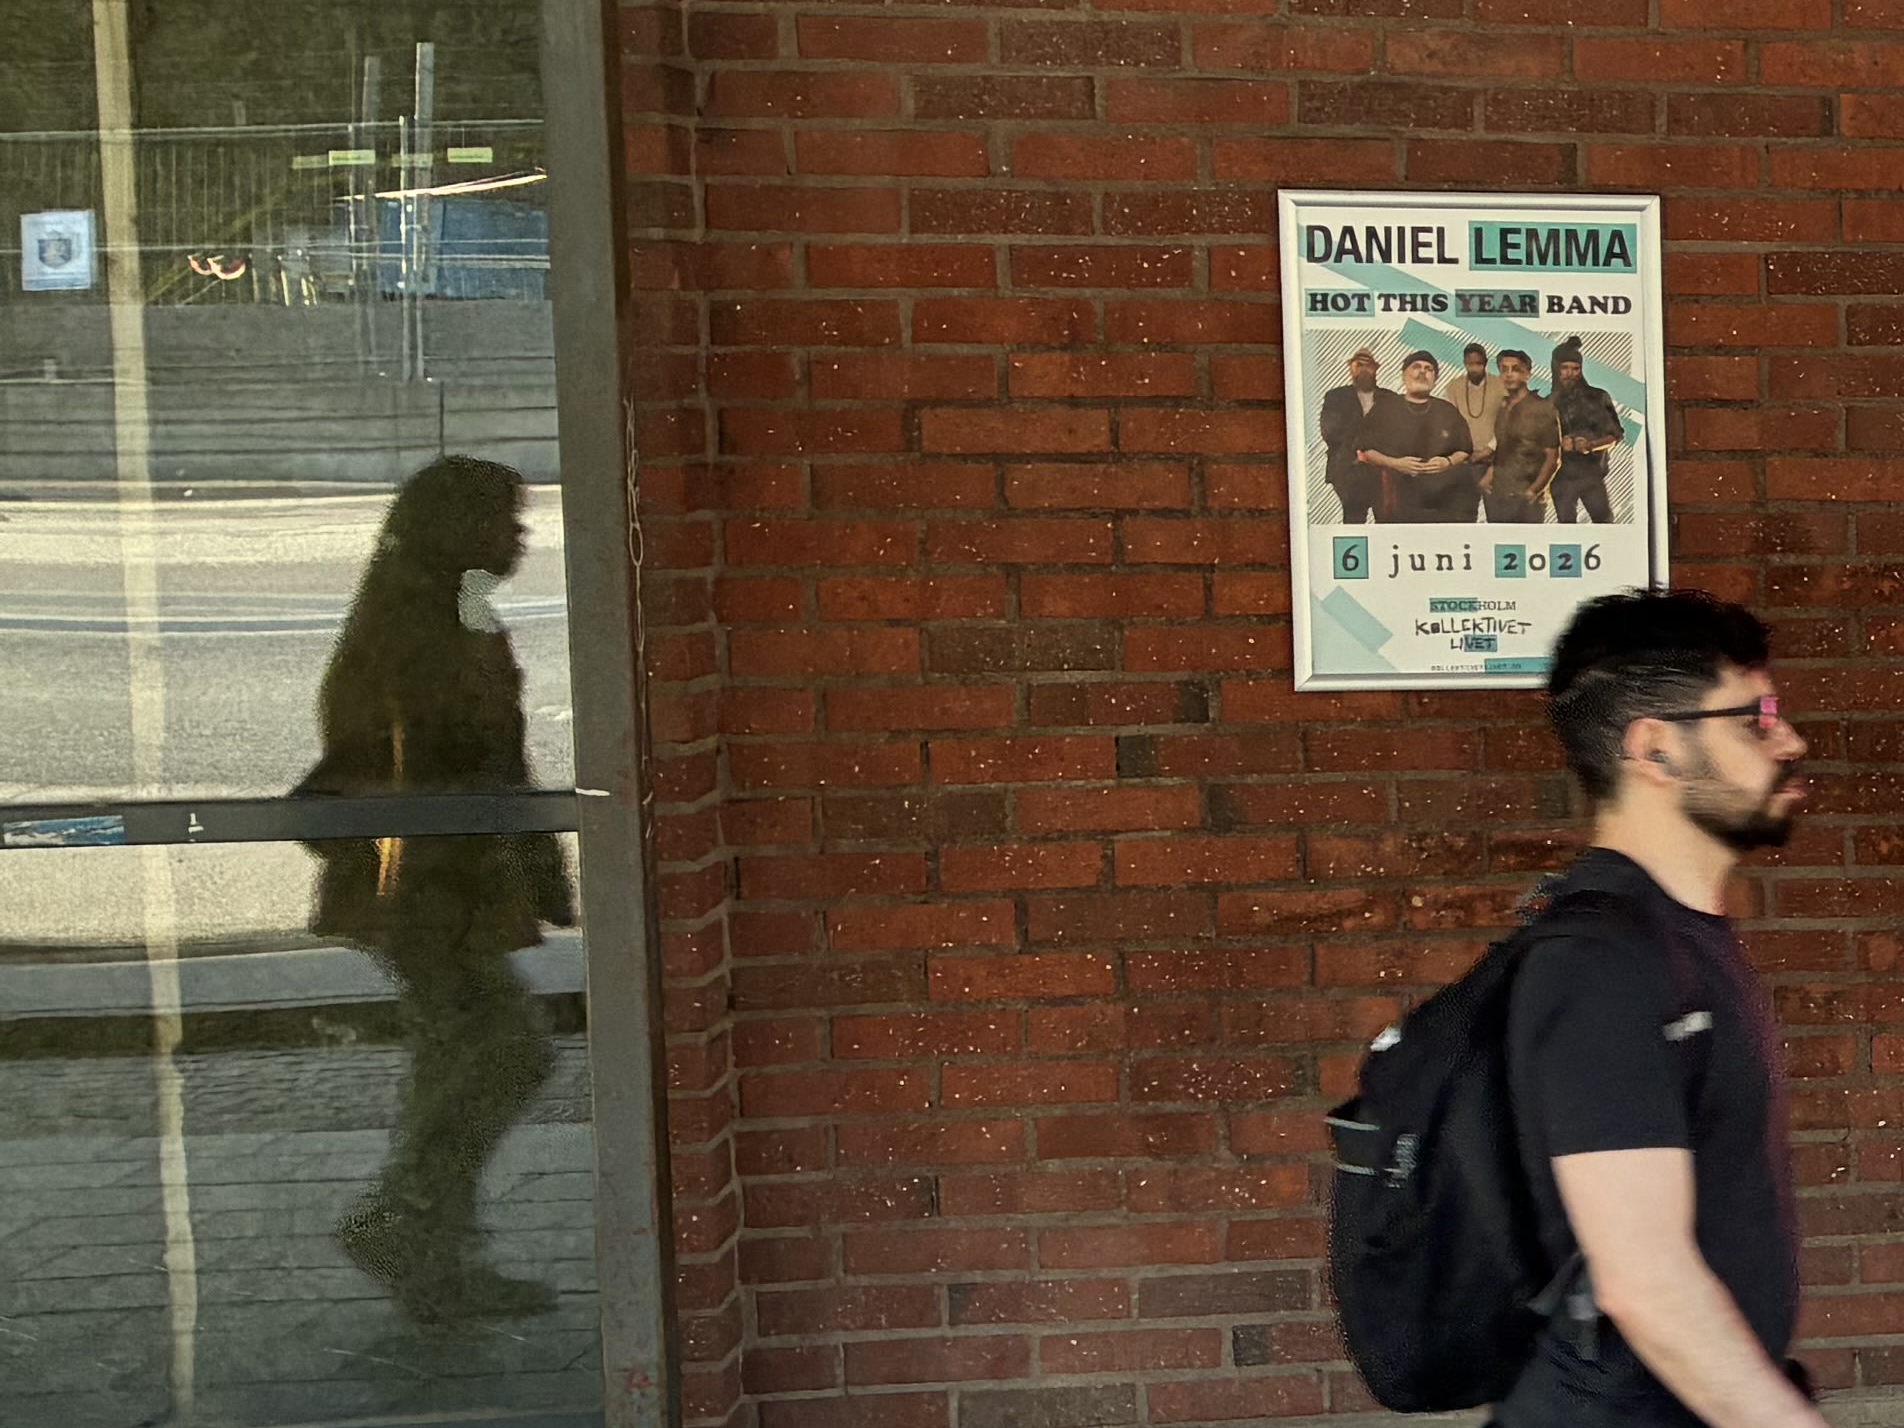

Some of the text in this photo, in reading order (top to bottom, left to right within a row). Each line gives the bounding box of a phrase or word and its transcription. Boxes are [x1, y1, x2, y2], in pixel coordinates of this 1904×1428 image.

[1305, 224, 1632, 268] DANIEL LEMMA
[1308, 292, 1632, 315] HOT THIS YEAR BAND
[1342, 541, 1601, 579] 6 juni 2026
[1430, 600, 1517, 612] STOCKHOLM
[1415, 617, 1532, 635] KOLLEKTIVET
[1450, 637, 1497, 650] LIVET
